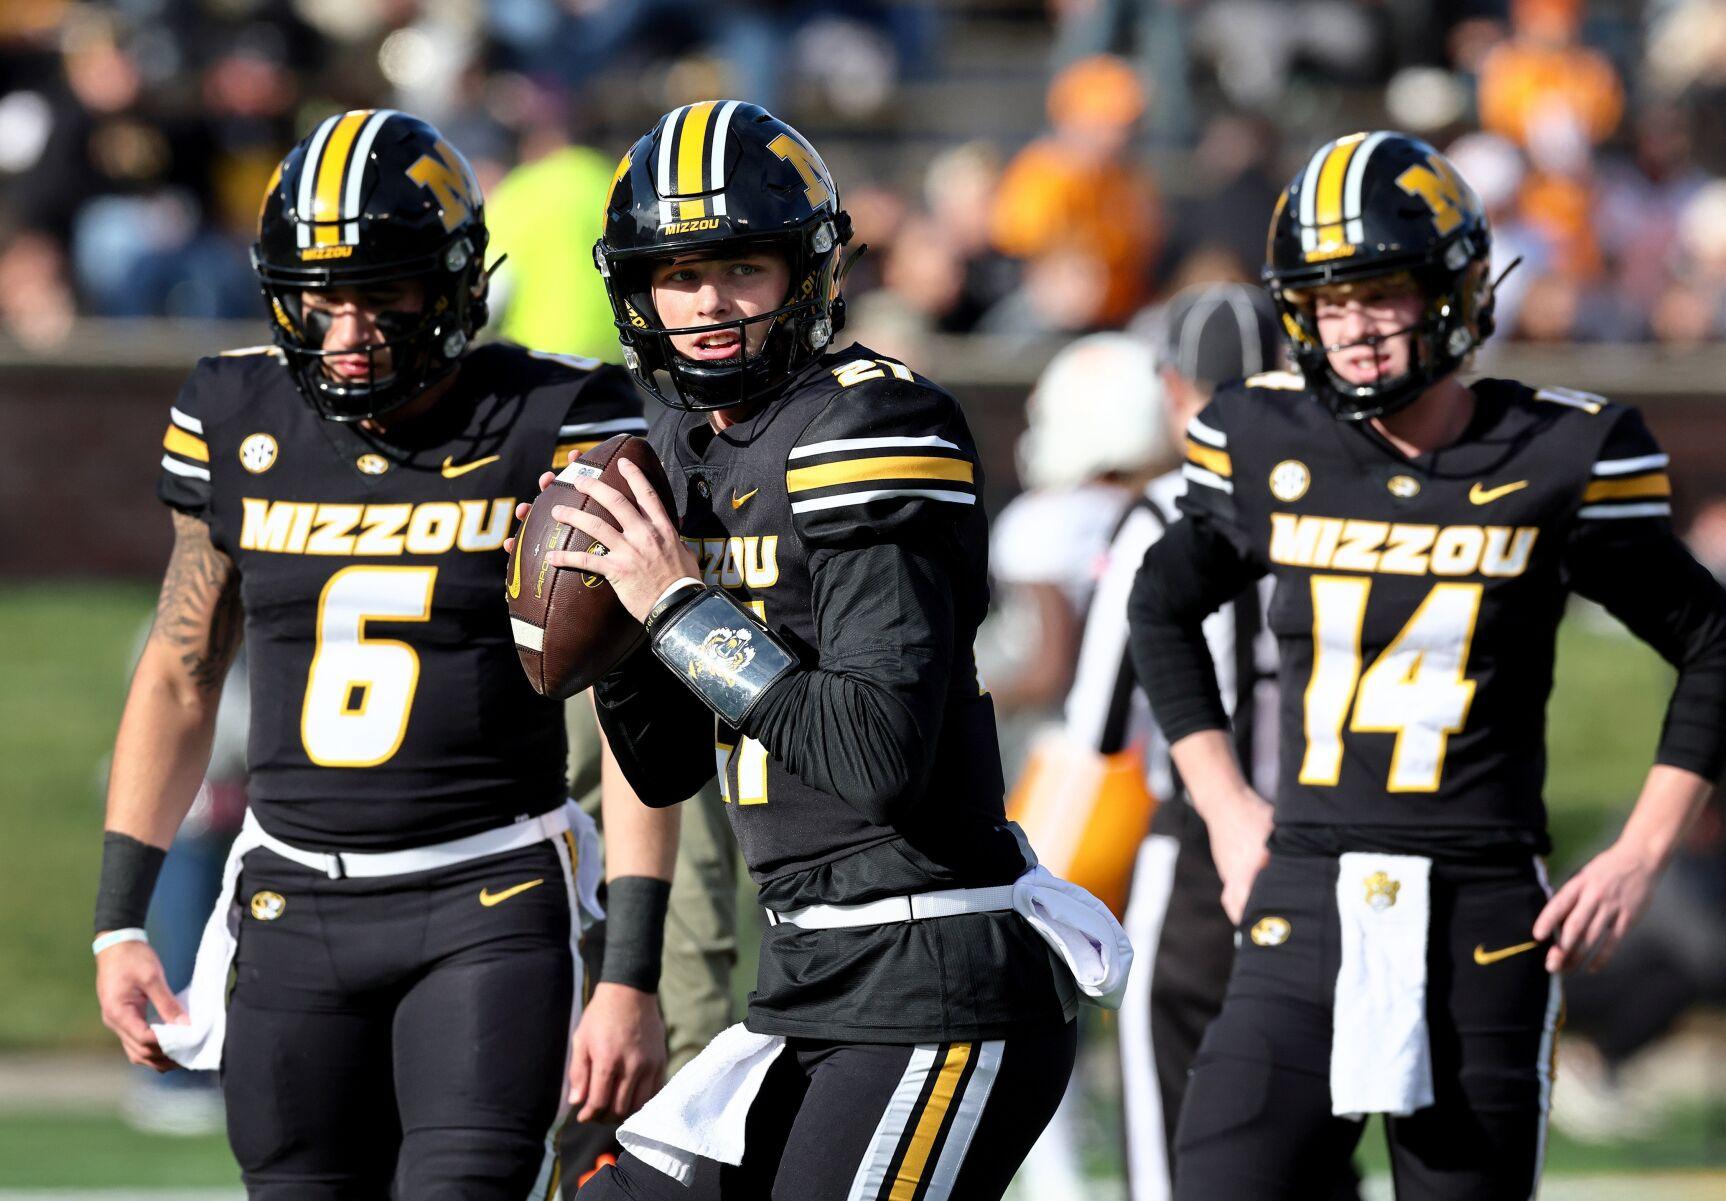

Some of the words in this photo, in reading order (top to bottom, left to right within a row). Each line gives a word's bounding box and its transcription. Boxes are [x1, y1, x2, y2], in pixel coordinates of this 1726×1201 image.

[665, 218, 720, 236] MIZZOU
[831, 359, 915, 387] 21
[239, 497, 516, 557] MIZZOU
[1269, 512, 1540, 578] MIZZOU
[534, 559, 551, 599] VAPO
[301, 564, 439, 768] 6
[1298, 573, 1485, 793] 14
